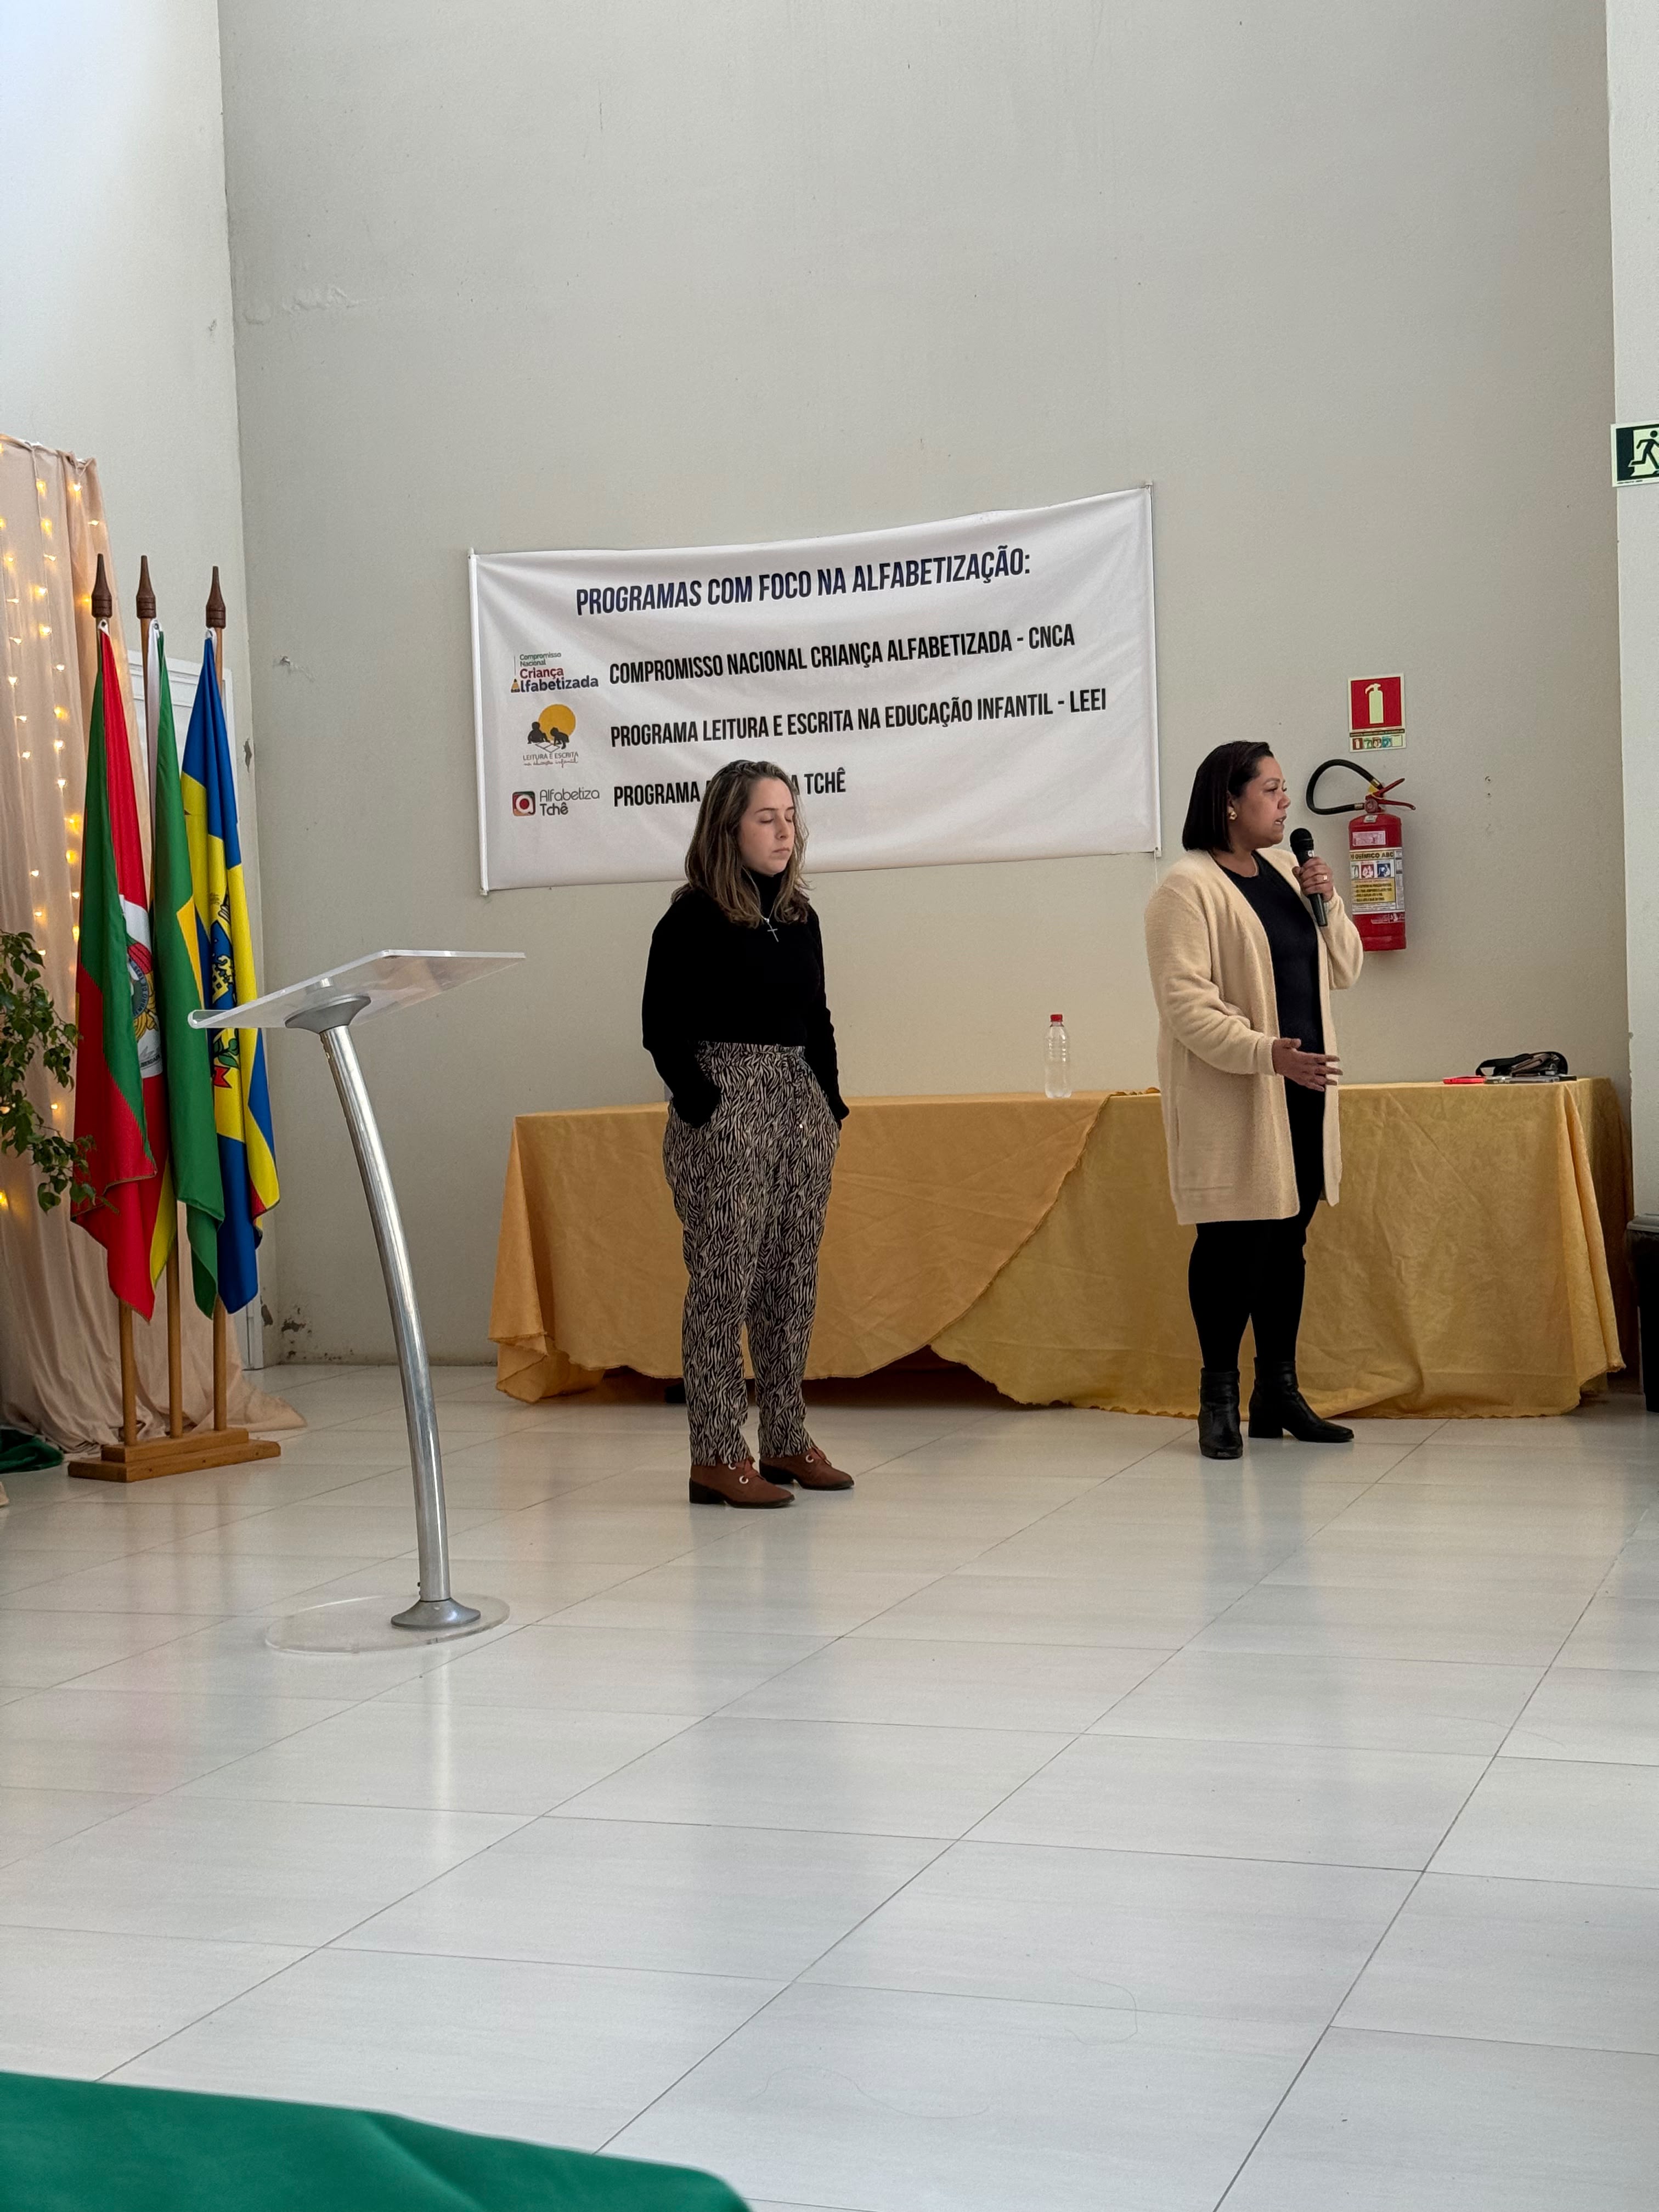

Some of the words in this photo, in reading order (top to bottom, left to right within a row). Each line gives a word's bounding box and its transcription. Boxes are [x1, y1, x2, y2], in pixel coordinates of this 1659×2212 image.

[577, 580, 702, 616] PROGRAMAS
[708, 575, 753, 605] COM
[758, 570, 811, 601] FOCO
[817, 567, 847, 596] NA
[852, 545, 1030, 593] ALFABETIZAÇÃO:
[520, 652, 562, 661] Compromisso
[610, 654, 724, 684] COMPROMISSO
[726, 647, 808, 675] NACIONAL
[810, 641, 883, 668] CRIANÇA
[887, 629, 1013, 662] ALFABETIZADA
[1029, 624, 1075, 650] CNCA
[520, 667, 564, 680] Criança
[611, 721, 698, 748] PROGRAMA
[703, 716, 769, 741] LEITURA
[773, 715, 783, 737] E
[787, 709, 854, 736] ESCRITA
[857, 707, 881, 730] NA
[885, 697, 973, 728] EDUCAÇÃO
[977, 693, 1053, 720] INFANTIL
[1070, 688, 1106, 713] LEEI
[540, 787, 600, 802] Alfabetiza
[613, 781, 701, 807] PROGRAMA
[804, 767, 846, 795] TCHÊ
[540, 802, 568, 816] Tchê
